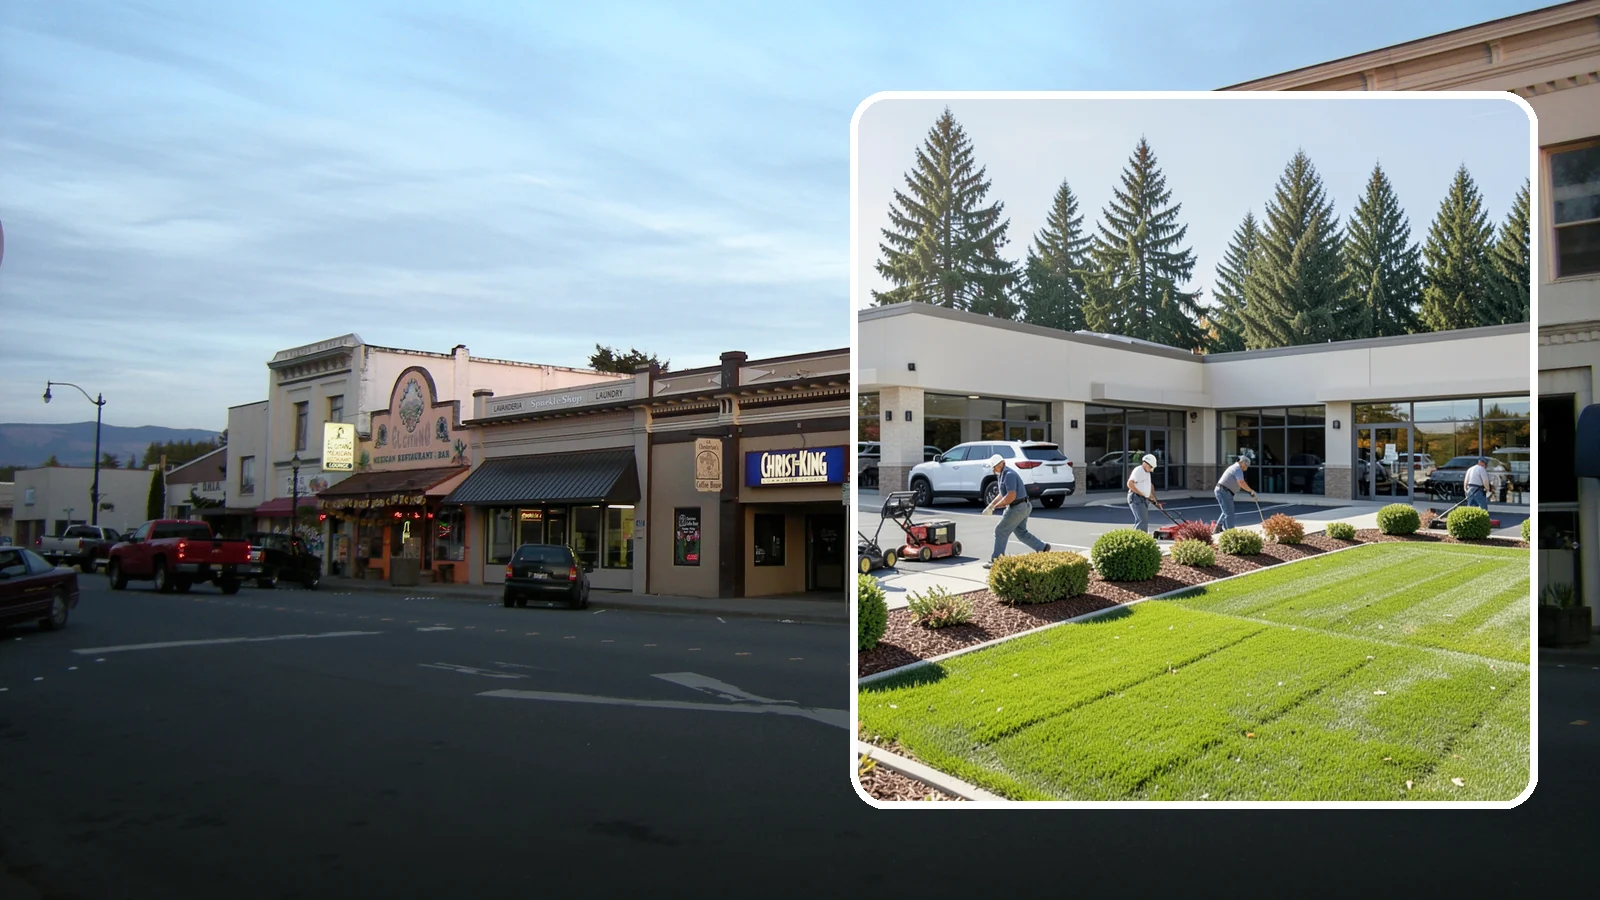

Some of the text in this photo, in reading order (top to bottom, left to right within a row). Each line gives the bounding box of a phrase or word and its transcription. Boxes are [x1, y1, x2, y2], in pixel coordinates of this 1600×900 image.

[595, 389, 623, 400] LAUNDRY
[493, 402, 522, 412] LAVANDERIA
[531, 395, 582, 409] Sparkle Shop
[373, 455, 396, 464] MEXICAN
[398, 452, 433, 462] RESTAURANT
[438, 450, 450, 459] BAR
[761, 450, 827, 477] CHRIST KING
